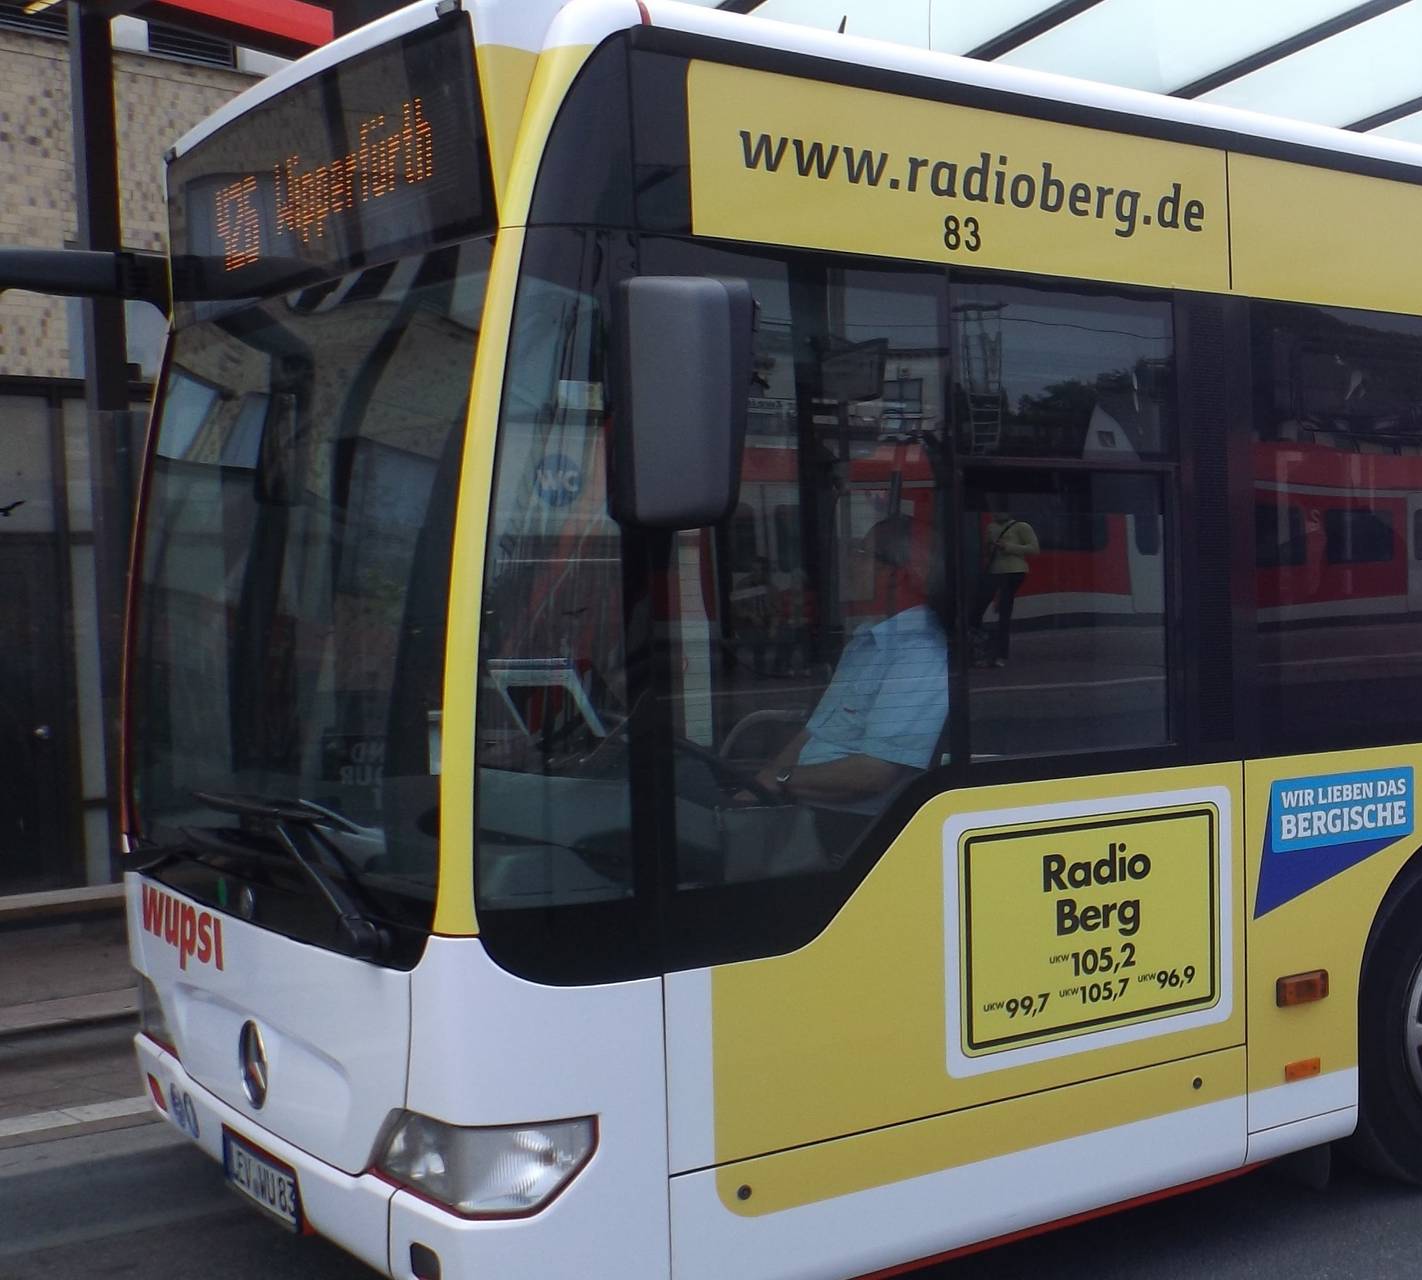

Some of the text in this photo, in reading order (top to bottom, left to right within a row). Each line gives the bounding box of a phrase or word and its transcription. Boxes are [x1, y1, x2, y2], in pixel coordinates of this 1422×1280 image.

[740, 130, 1206, 237] www.radioberg.de
[944, 215, 982, 252] 83
[1281, 778, 1406, 809] WIR LIEBEN DAS
[1280, 800, 1406, 840] BERGISCHE
[1042, 842, 1152, 893] Radio
[1056, 898, 1141, 937] Berg
[1049, 942, 1136, 977] UKW 105,2
[983, 965, 1196, 1019] UKW 99,7 UKW 105,7 UKW 96,9
